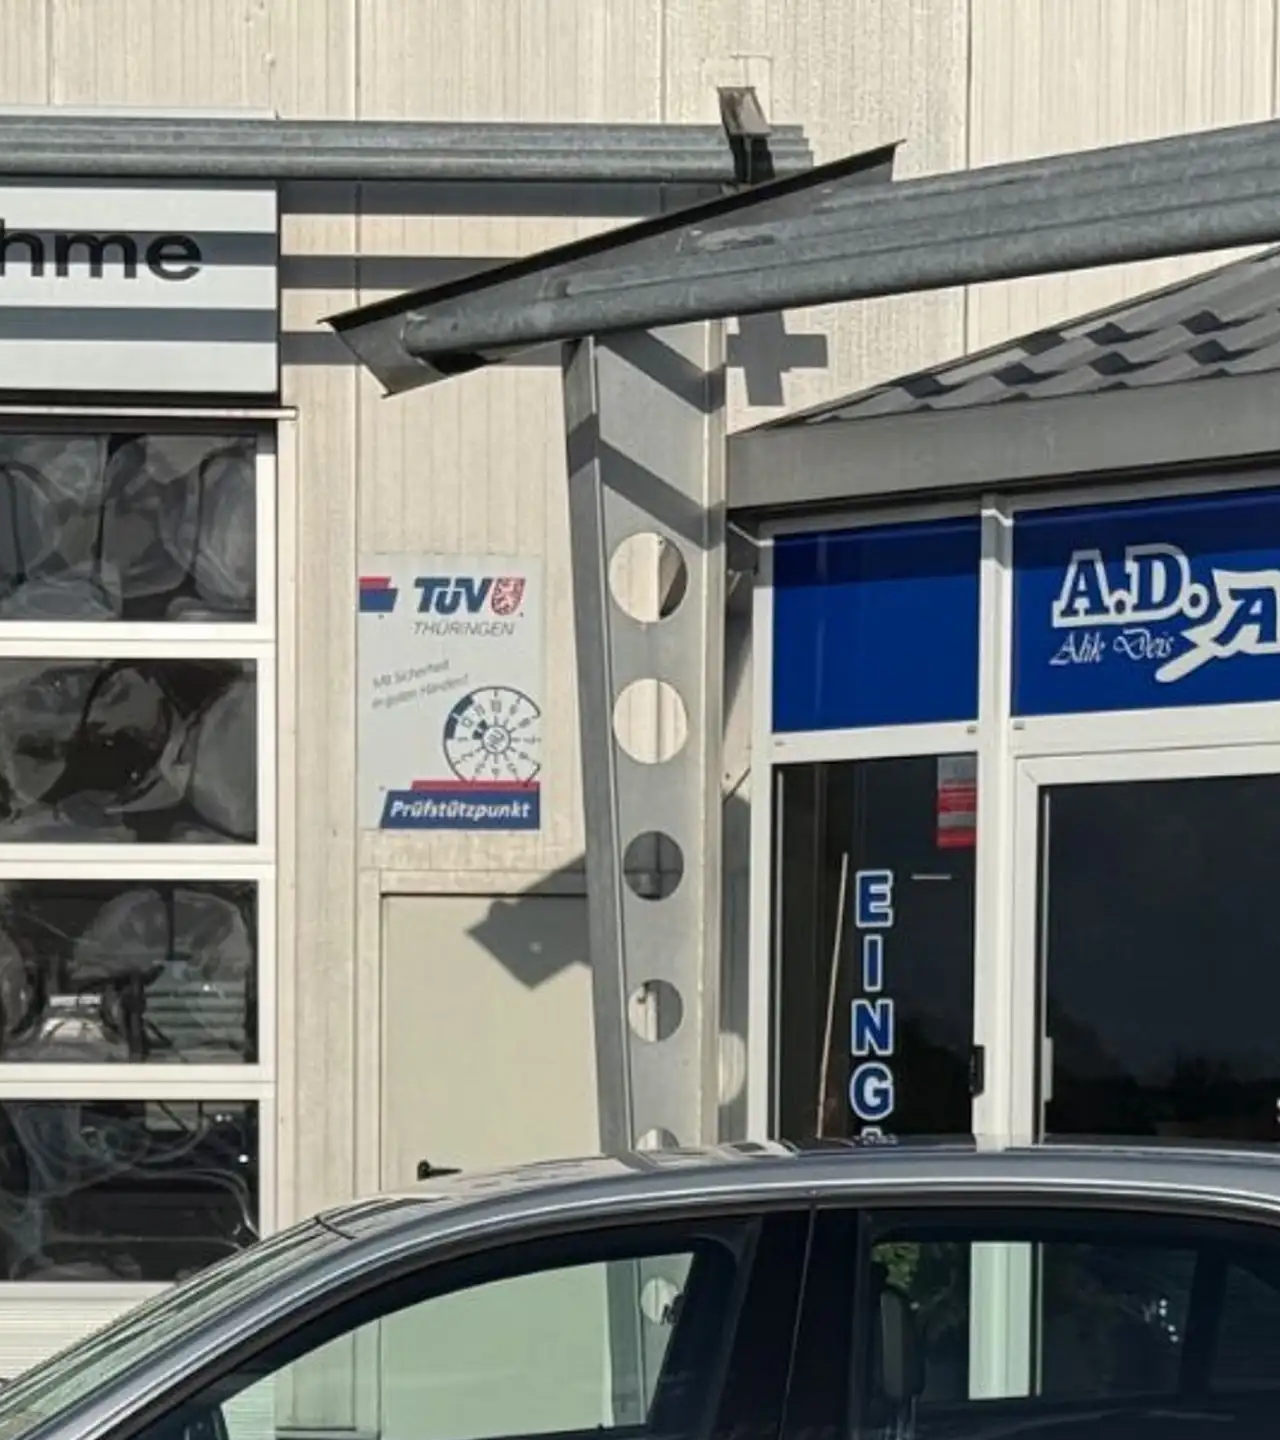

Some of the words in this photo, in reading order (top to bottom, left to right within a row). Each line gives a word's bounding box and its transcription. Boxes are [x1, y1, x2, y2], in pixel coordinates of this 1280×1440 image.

[1053, 543, 1209, 628] A.D.
[413, 619, 516, 637] THÜRINGEN
[390, 799, 530, 820] Prüfstützpunkt
[850, 869, 894, 1137] EING
